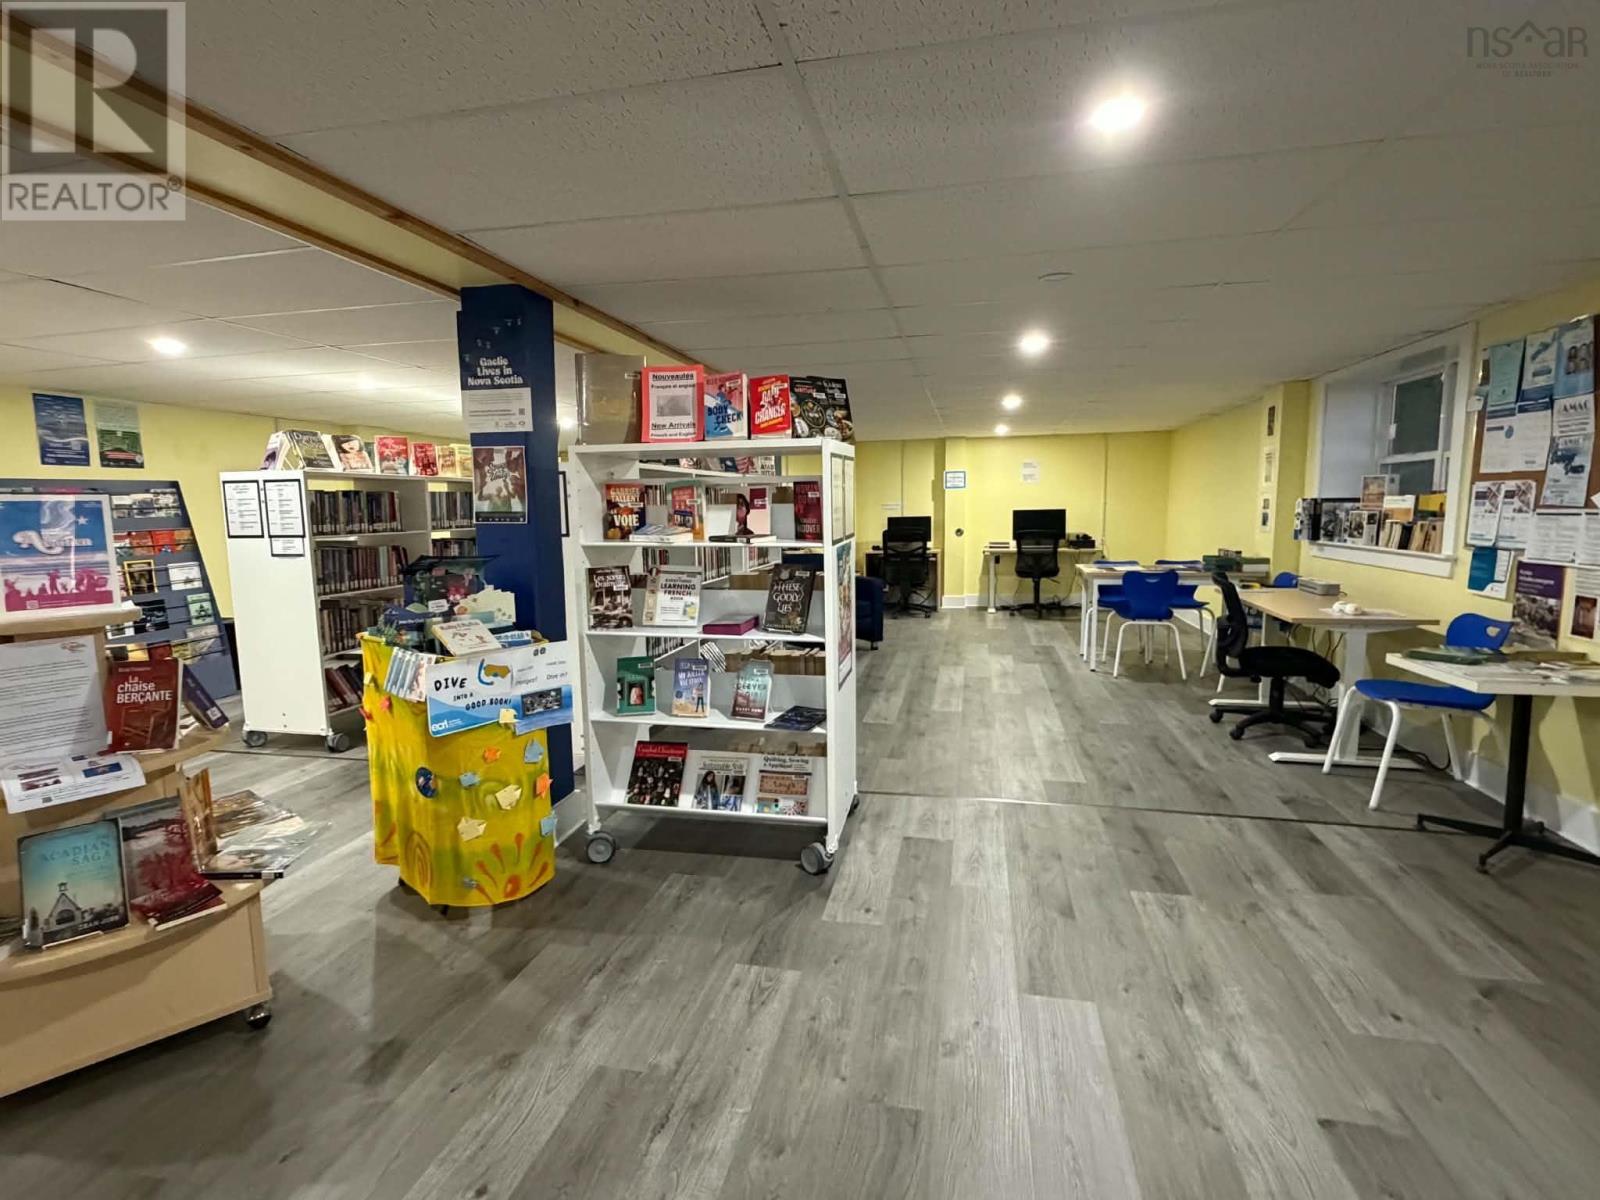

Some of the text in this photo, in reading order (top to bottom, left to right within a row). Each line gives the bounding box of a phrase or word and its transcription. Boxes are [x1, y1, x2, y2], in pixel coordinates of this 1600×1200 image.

[477, 366, 513, 377] Lives in
[467, 375, 524, 386] Nova Scotia
[707, 405, 729, 416] BODY
[651, 422, 667, 430] New
[613, 514, 640, 527] VOIE
[128, 675, 139, 683] La
[434, 677, 467, 691] DIVE
[117, 681, 156, 693] chaise
[116, 690, 173, 704] BERÇANTE
[453, 693, 468, 701] INTO
[465, 699, 487, 711] GOOD
[41, 841, 111, 862] ACADIAN
[72, 850, 111, 865] SAGA
